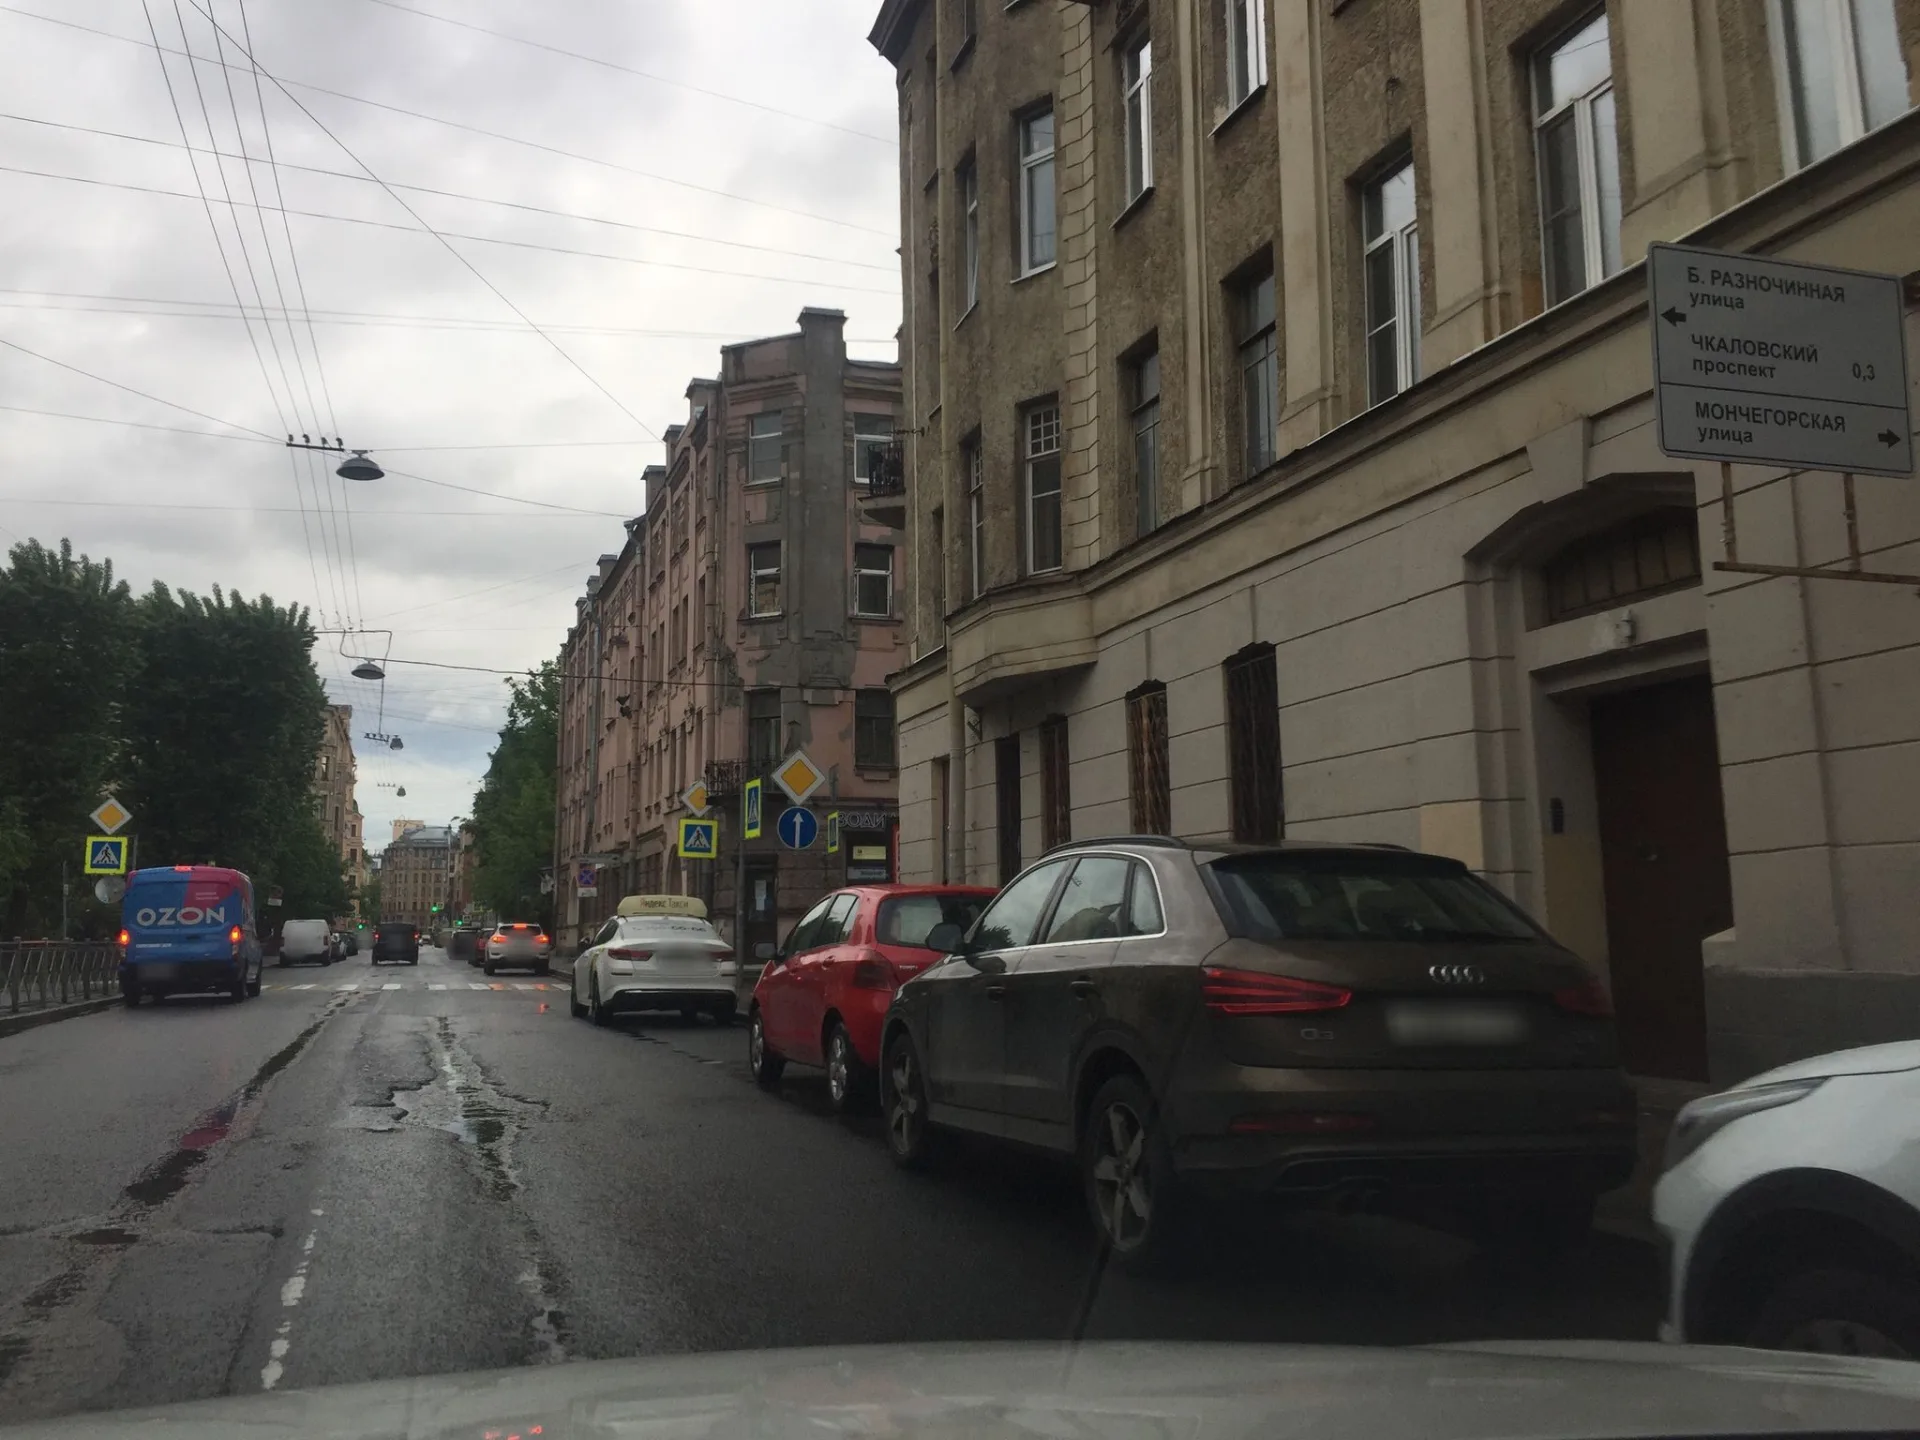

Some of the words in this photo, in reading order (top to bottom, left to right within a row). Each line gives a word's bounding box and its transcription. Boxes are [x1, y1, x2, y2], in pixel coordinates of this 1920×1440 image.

[1687, 266, 1705, 285] Б.
[1710, 269, 1846, 303] РАЗНОЧИННАЯ
[1689, 291, 1745, 310] улица
[1690, 333, 1818, 363] ЧКАЛОВСКИЙ
[1692, 358, 1776, 379] проспект
[1851, 362, 1876, 382] 0,3
[1695, 401, 1846, 433] МОНЧЕГОРСКАЯ
[1697, 425, 1753, 445] улица
[136, 906, 225, 926] OZON
